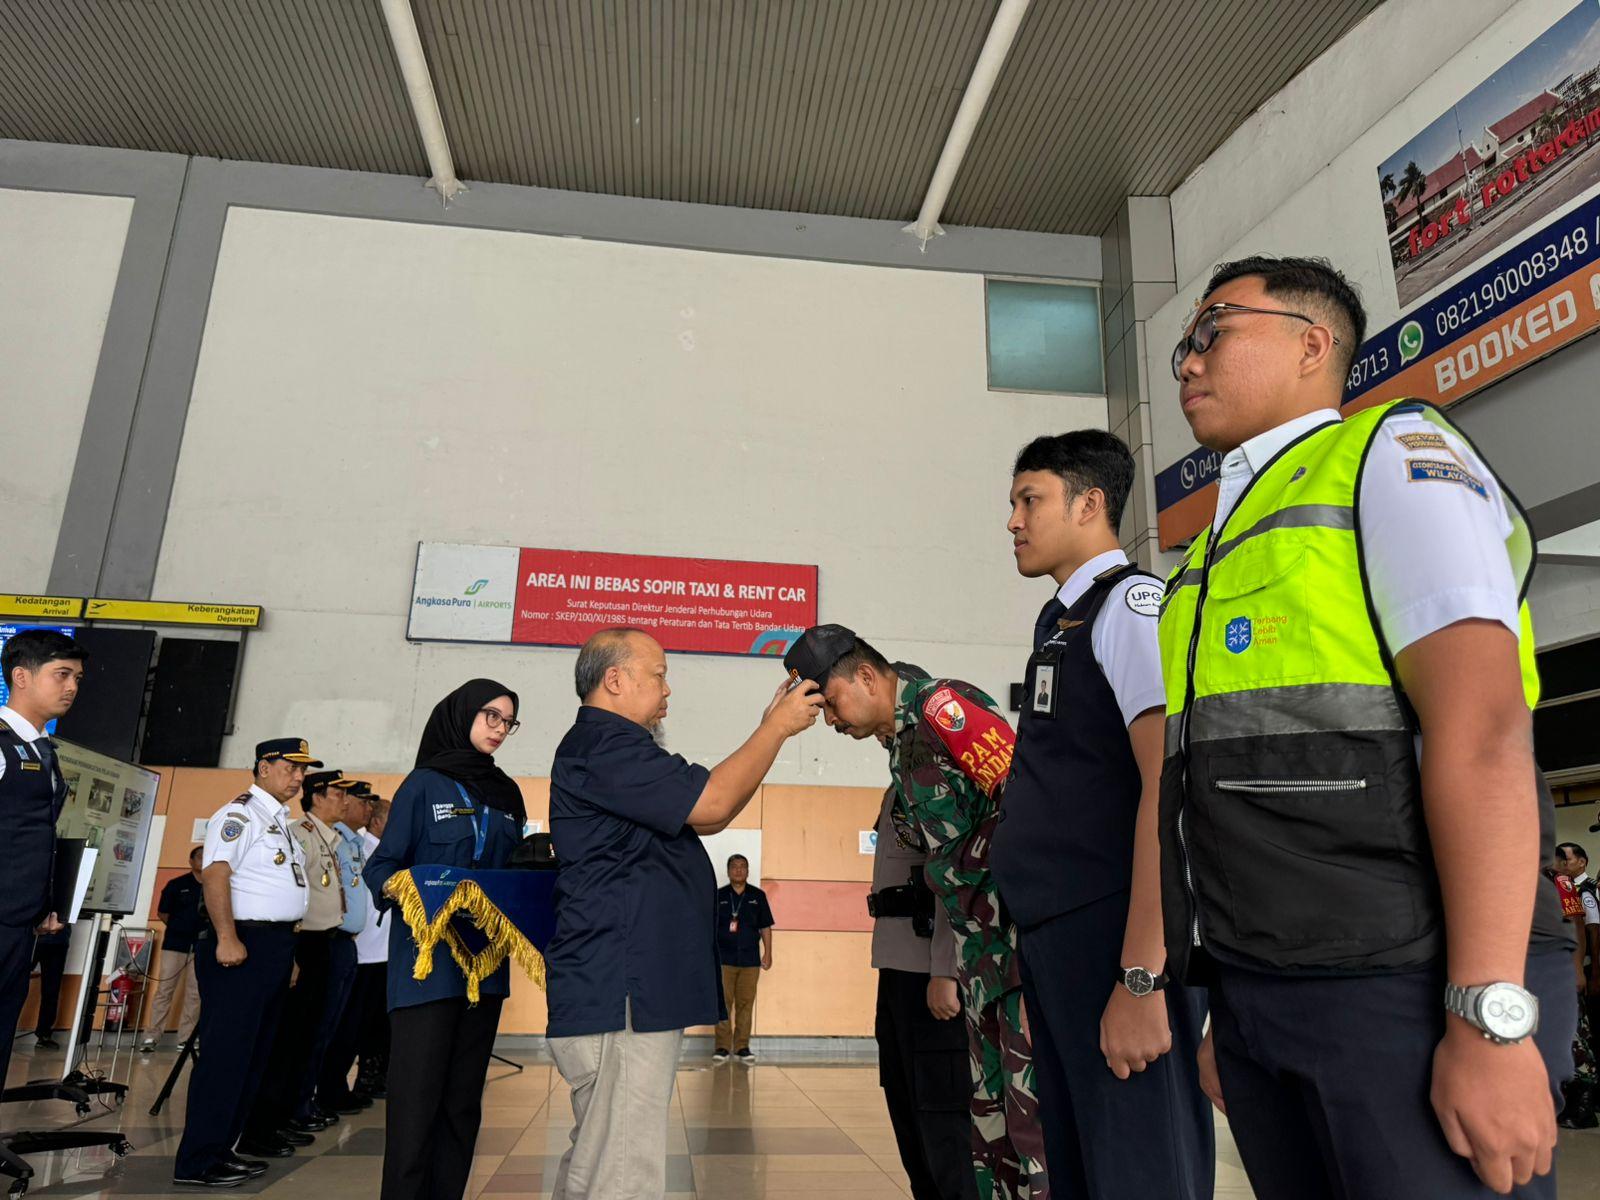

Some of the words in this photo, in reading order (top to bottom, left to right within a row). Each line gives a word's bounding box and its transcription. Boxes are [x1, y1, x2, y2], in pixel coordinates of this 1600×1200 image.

[1408, 197, 1471, 257] fort
[1436, 226, 1588, 336] 082190008348
[1434, 290, 1577, 393] BOOKED
[526, 573, 566, 588] AREA
[570, 575, 590, 590] INI
[594, 577, 640, 593] BEBAS
[643, 579, 686, 596] SOPIR
[689, 582, 719, 597] TAXI
[723, 584, 735, 598] &
[739, 585, 775, 601] RENT
[778, 587, 806, 602] CAR
[1132, 591, 1161, 601] UPG
[15, 595, 71, 607] Kedatangan
[187, 604, 256, 616] Keberangkatan
[478, 600, 512, 609] AIRPORTS
[567, 599, 587, 608] Surat
[589, 600, 630, 611] Keputusan
[632, 602, 662, 612] Direktur
[665, 604, 697, 614] Jenderal
[698, 606, 748, 618] Perhubungan
[750, 609, 773, 618] Udara
[42, 607, 69, 616] Arrival
[216, 614, 255, 624] Departure
[521, 610, 549, 620] Nomor
[628, 616, 657, 627] tentang
[659, 617, 697, 628] Peraturan
[698, 619, 712, 628] dan
[714, 620, 730, 629] Tata
[732, 621, 753, 630] Tertib
[755, 622, 782, 632] Bandar
[783, 623, 806, 632] Udara
[961, 727, 1007, 773] PAM
